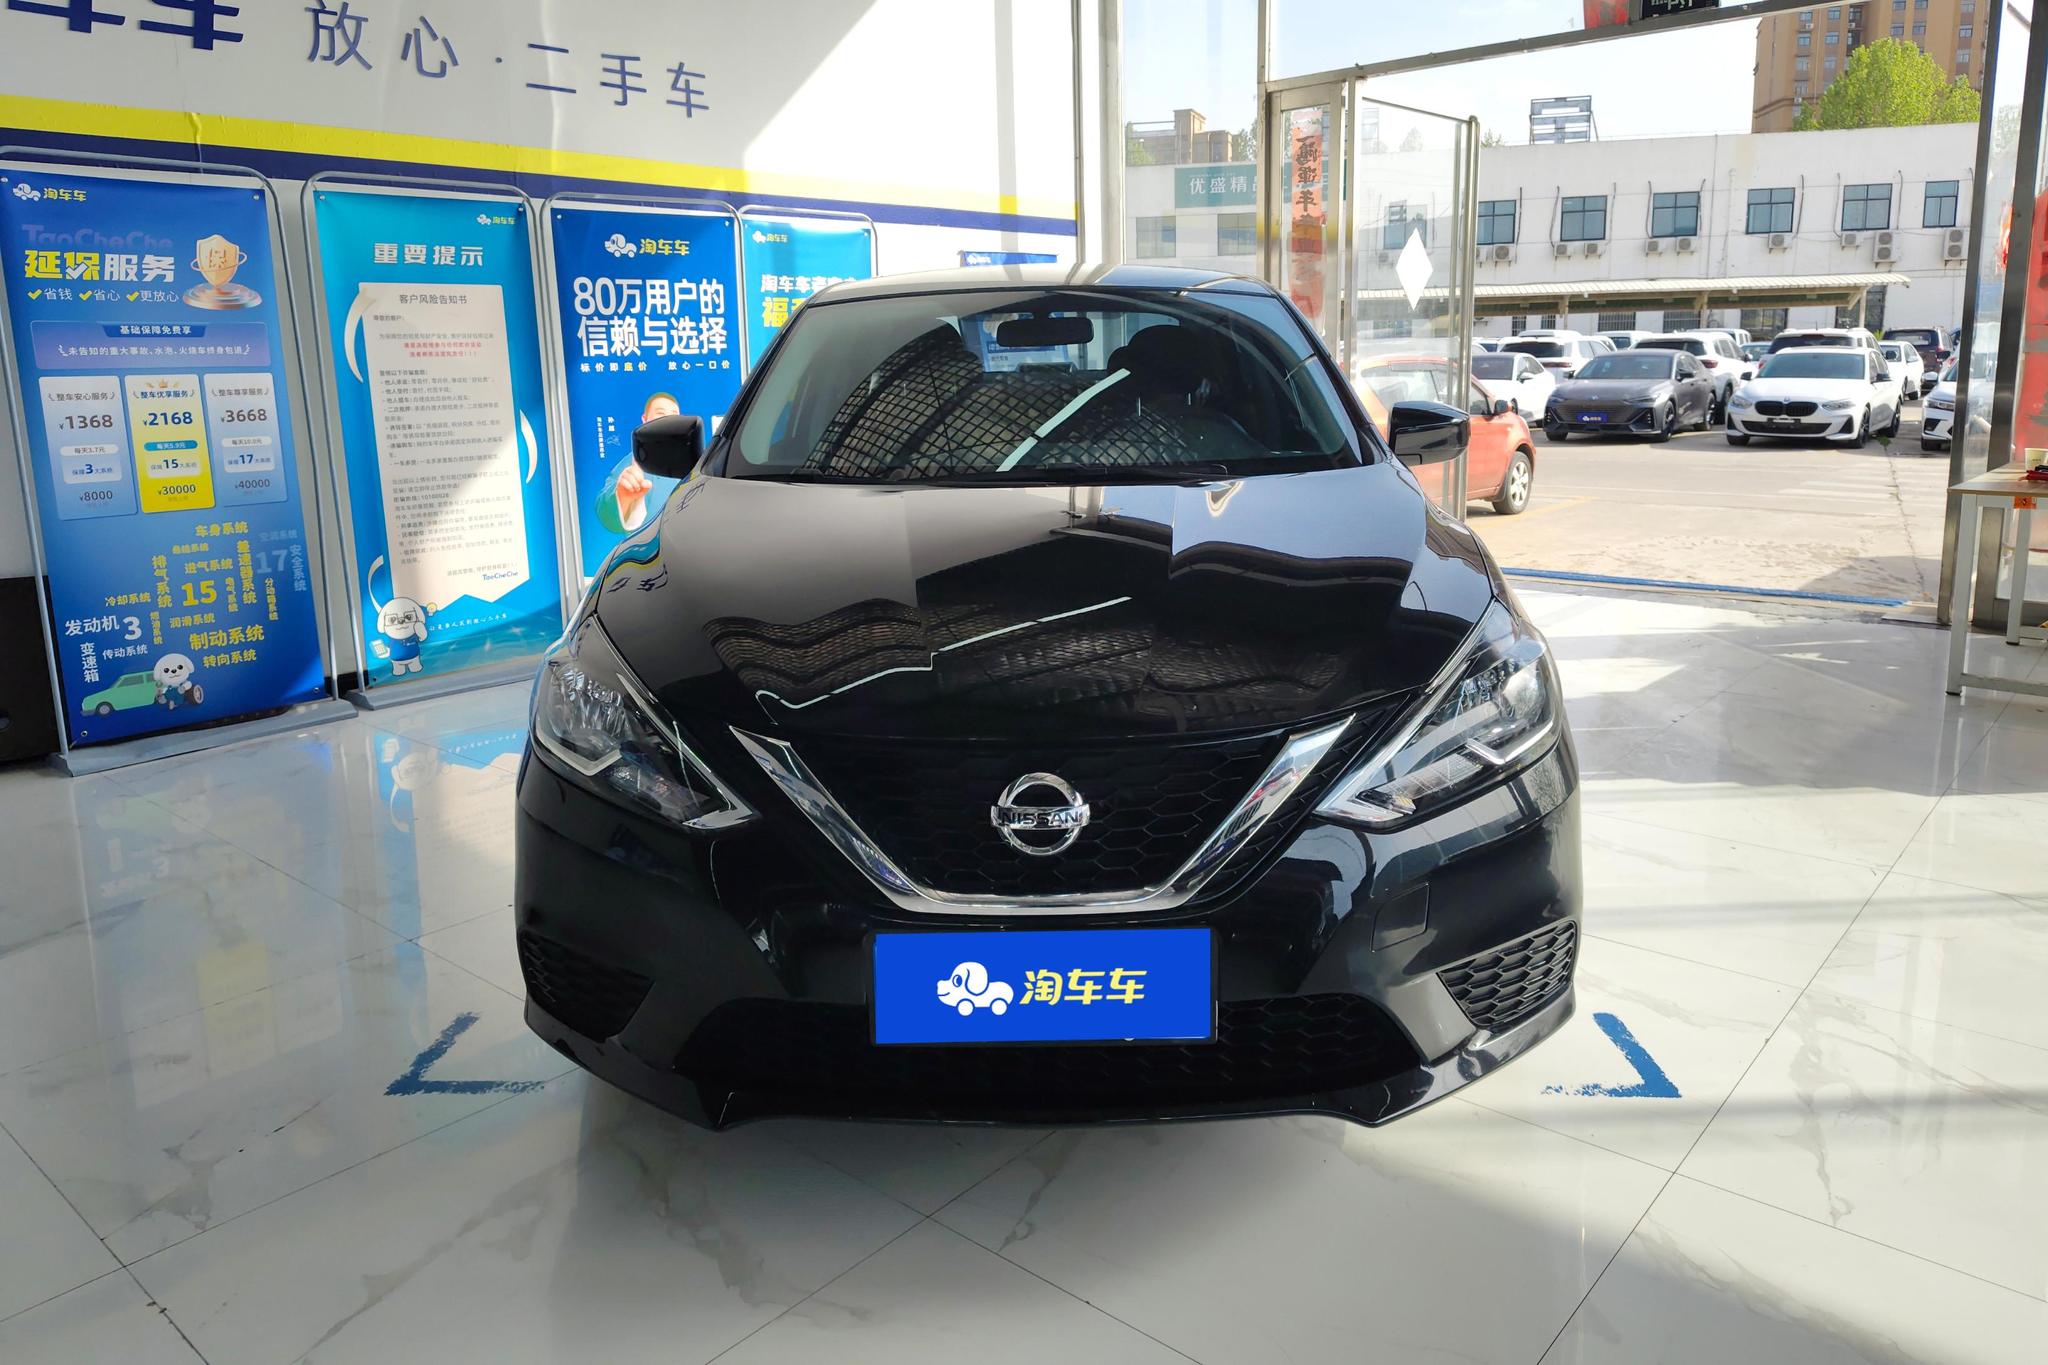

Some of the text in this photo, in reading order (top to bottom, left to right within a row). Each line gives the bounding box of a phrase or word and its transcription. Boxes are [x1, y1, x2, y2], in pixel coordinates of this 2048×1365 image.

[43, 188, 88, 202] 淘车车
[22, 224, 174, 249] TaoCheChe
[374, 242, 484, 266] 重要提示
[639, 239, 691, 256] 淘车车
[25, 249, 176, 283] 延保服务
[44, 288, 180, 303] 省钱 省心 更放心
[399, 294, 468, 305] 客户风险告知书
[573, 276, 725, 316] 80万用户的
[762, 297, 806, 329] 福
[120, 325, 192, 336] 基础保障免费享
[577, 315, 728, 357] 信赖与选择
[580, 359, 730, 373] 标价即底价 放心一口价
[56, 392, 109, 402] 整车安心服务
[140, 389, 189, 399] 整车优享服务
[218, 388, 264, 398] 整车尊享服务
[59, 414, 114, 431] ¥1368
[143, 411, 194, 427] ¥2168
[220, 408, 268, 423] ¥3668
[195, 521, 249, 538] 车身系统
[184, 558, 233, 576] 进气系统
[256, 549, 288, 574] 17
[289, 544, 307, 592] 安全系统
[152, 555, 173, 608] 排气系统
[105, 591, 152, 607] 冷却系统
[181, 580, 218, 607] 15
[65, 616, 120, 637] 发动机
[122, 616, 143, 641] 3
[170, 612, 216, 629] 润滑系统
[189, 624, 265, 651] 制动系统
[102, 643, 149, 660] 传动系统
[203, 649, 257, 669] 转向系统
[80, 642, 100, 683] 变速箱
[1001, 808, 1080, 826] NISSAN
